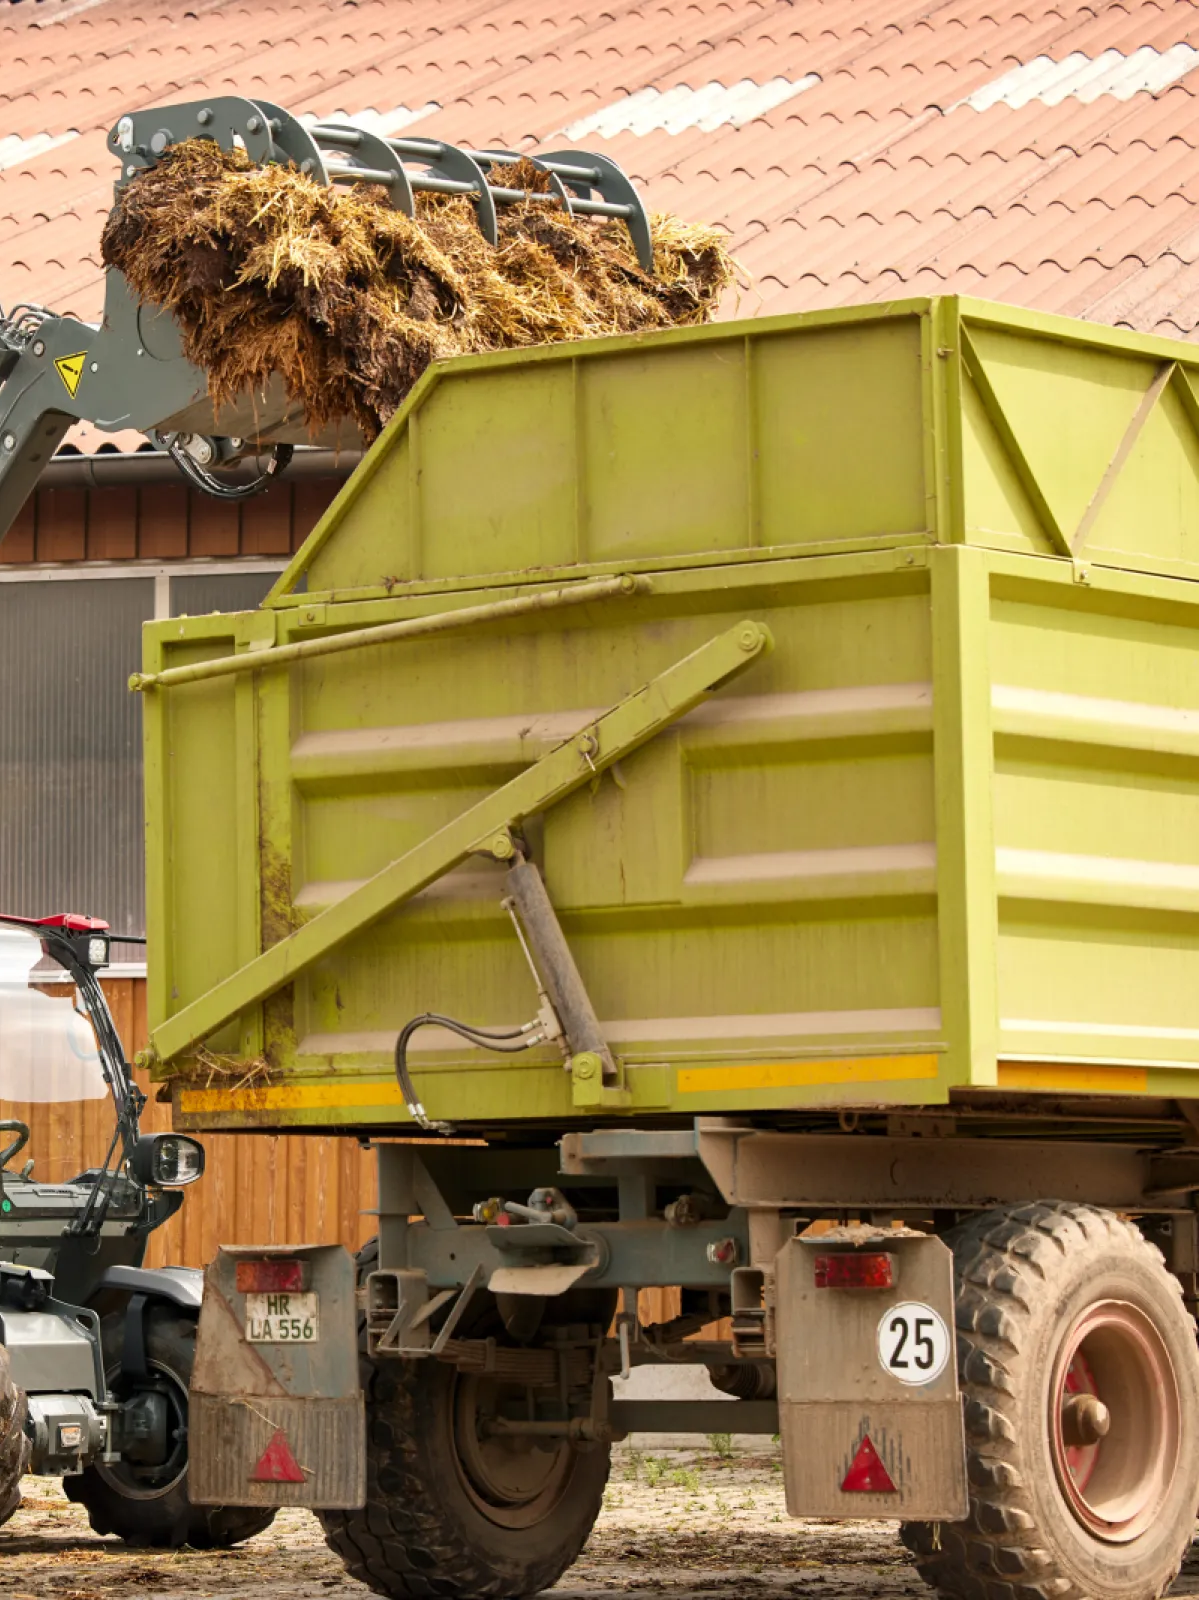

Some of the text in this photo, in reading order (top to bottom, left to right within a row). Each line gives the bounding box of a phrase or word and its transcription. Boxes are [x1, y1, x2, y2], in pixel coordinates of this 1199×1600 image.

[267, 1295, 290, 1315] HR
[251, 1319, 313, 1339] LA 556
[890, 1317, 934, 1369] 25
